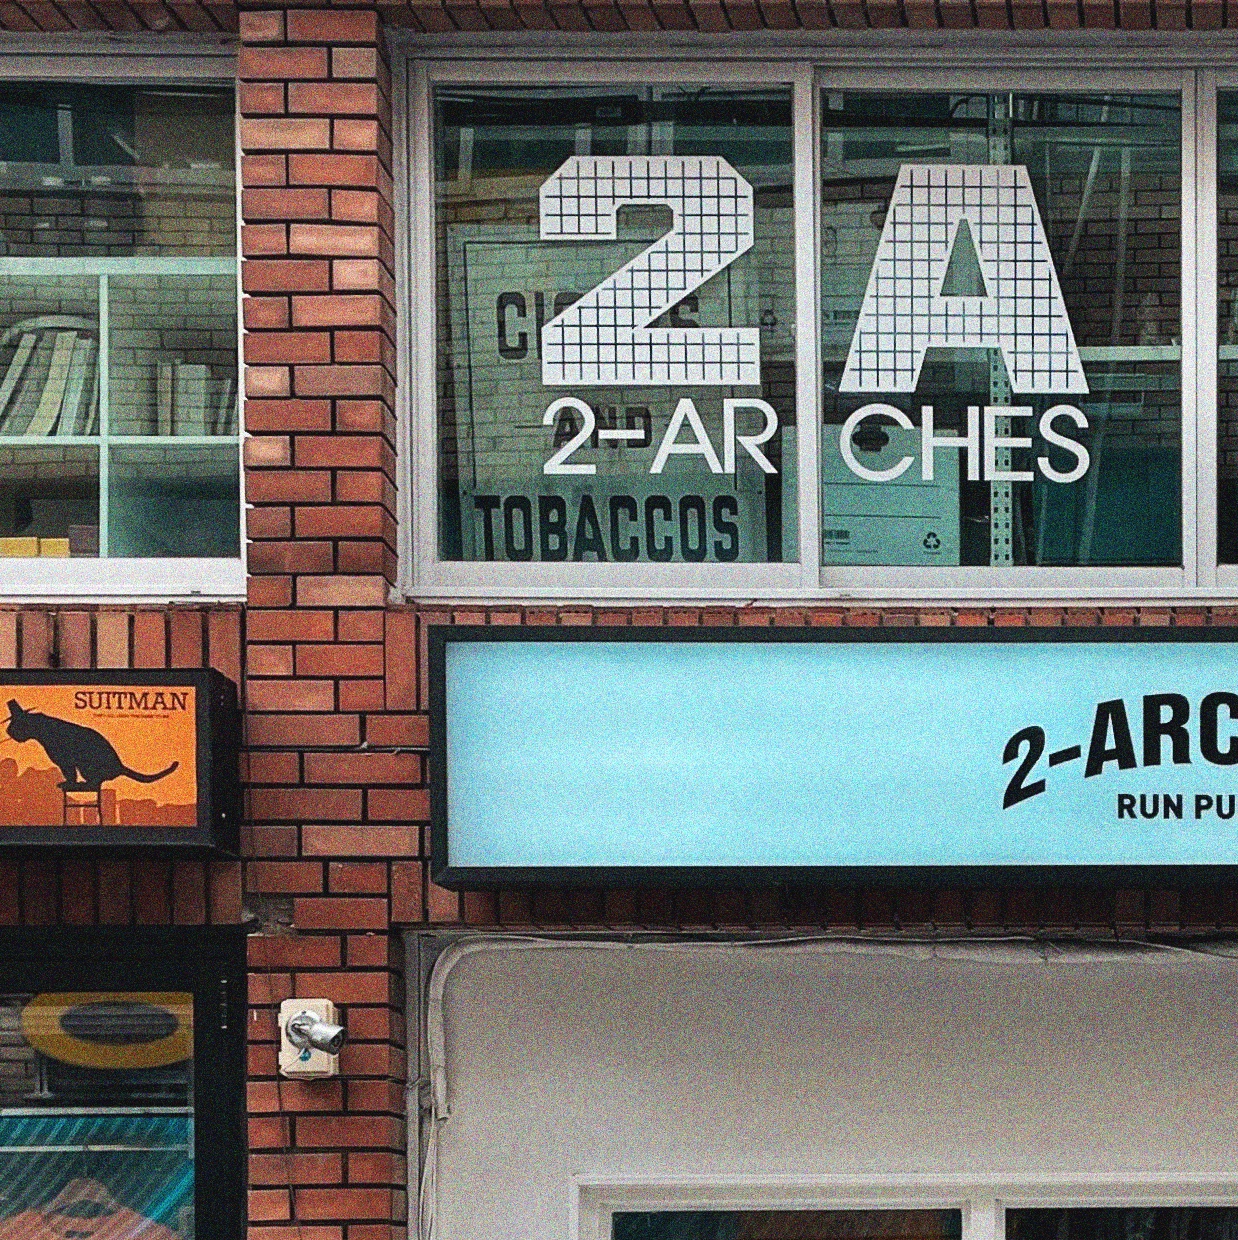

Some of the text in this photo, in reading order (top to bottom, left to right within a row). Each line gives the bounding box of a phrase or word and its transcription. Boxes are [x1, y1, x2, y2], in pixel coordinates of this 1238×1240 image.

[474, 495, 740, 562] TOBACCOS
[74, 691, 188, 711] SUITMAN
[1117, 793, 1184, 820] RUN
